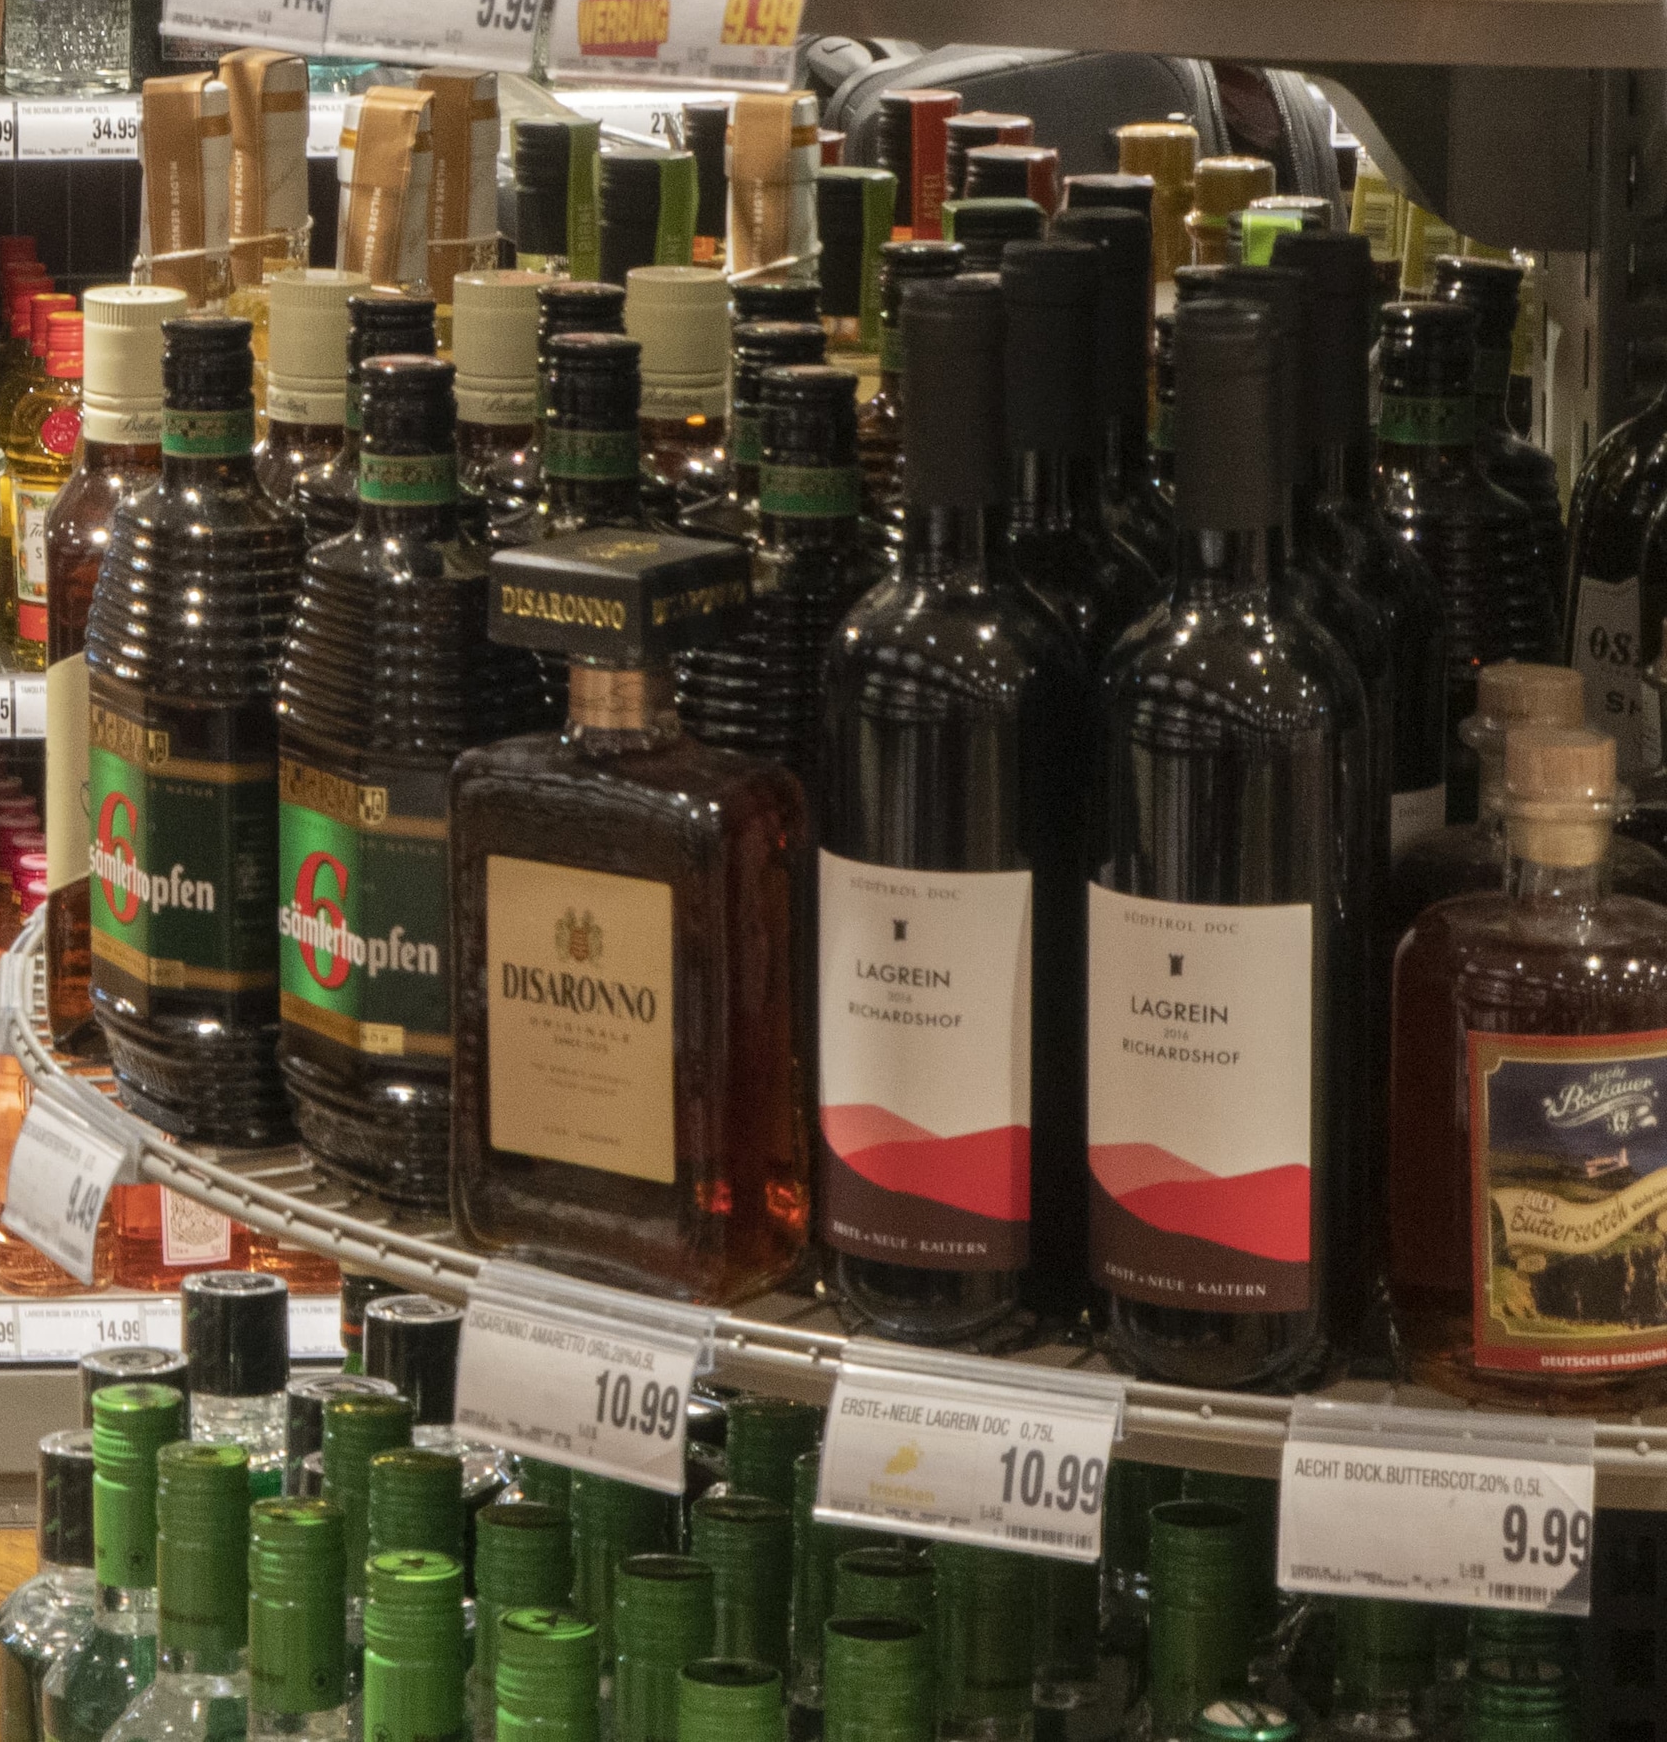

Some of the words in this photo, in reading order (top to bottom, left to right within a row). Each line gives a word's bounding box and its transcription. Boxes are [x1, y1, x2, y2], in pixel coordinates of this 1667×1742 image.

[501, 583, 627, 630] DISARONNO
[502, 960, 657, 1024] DISARONNO
[1128, 995, 1230, 1026] LAGREIN
[1121, 1038, 1241, 1067] RICHARDSHOF
[594, 1369, 680, 1441] 10.99
[925, 1408, 980, 1432] LAGREIN
[981, 1413, 1010, 1436] DOC
[1000, 1445, 1104, 1514] 10.99
[1503, 1504, 1591, 1567] 9.99
